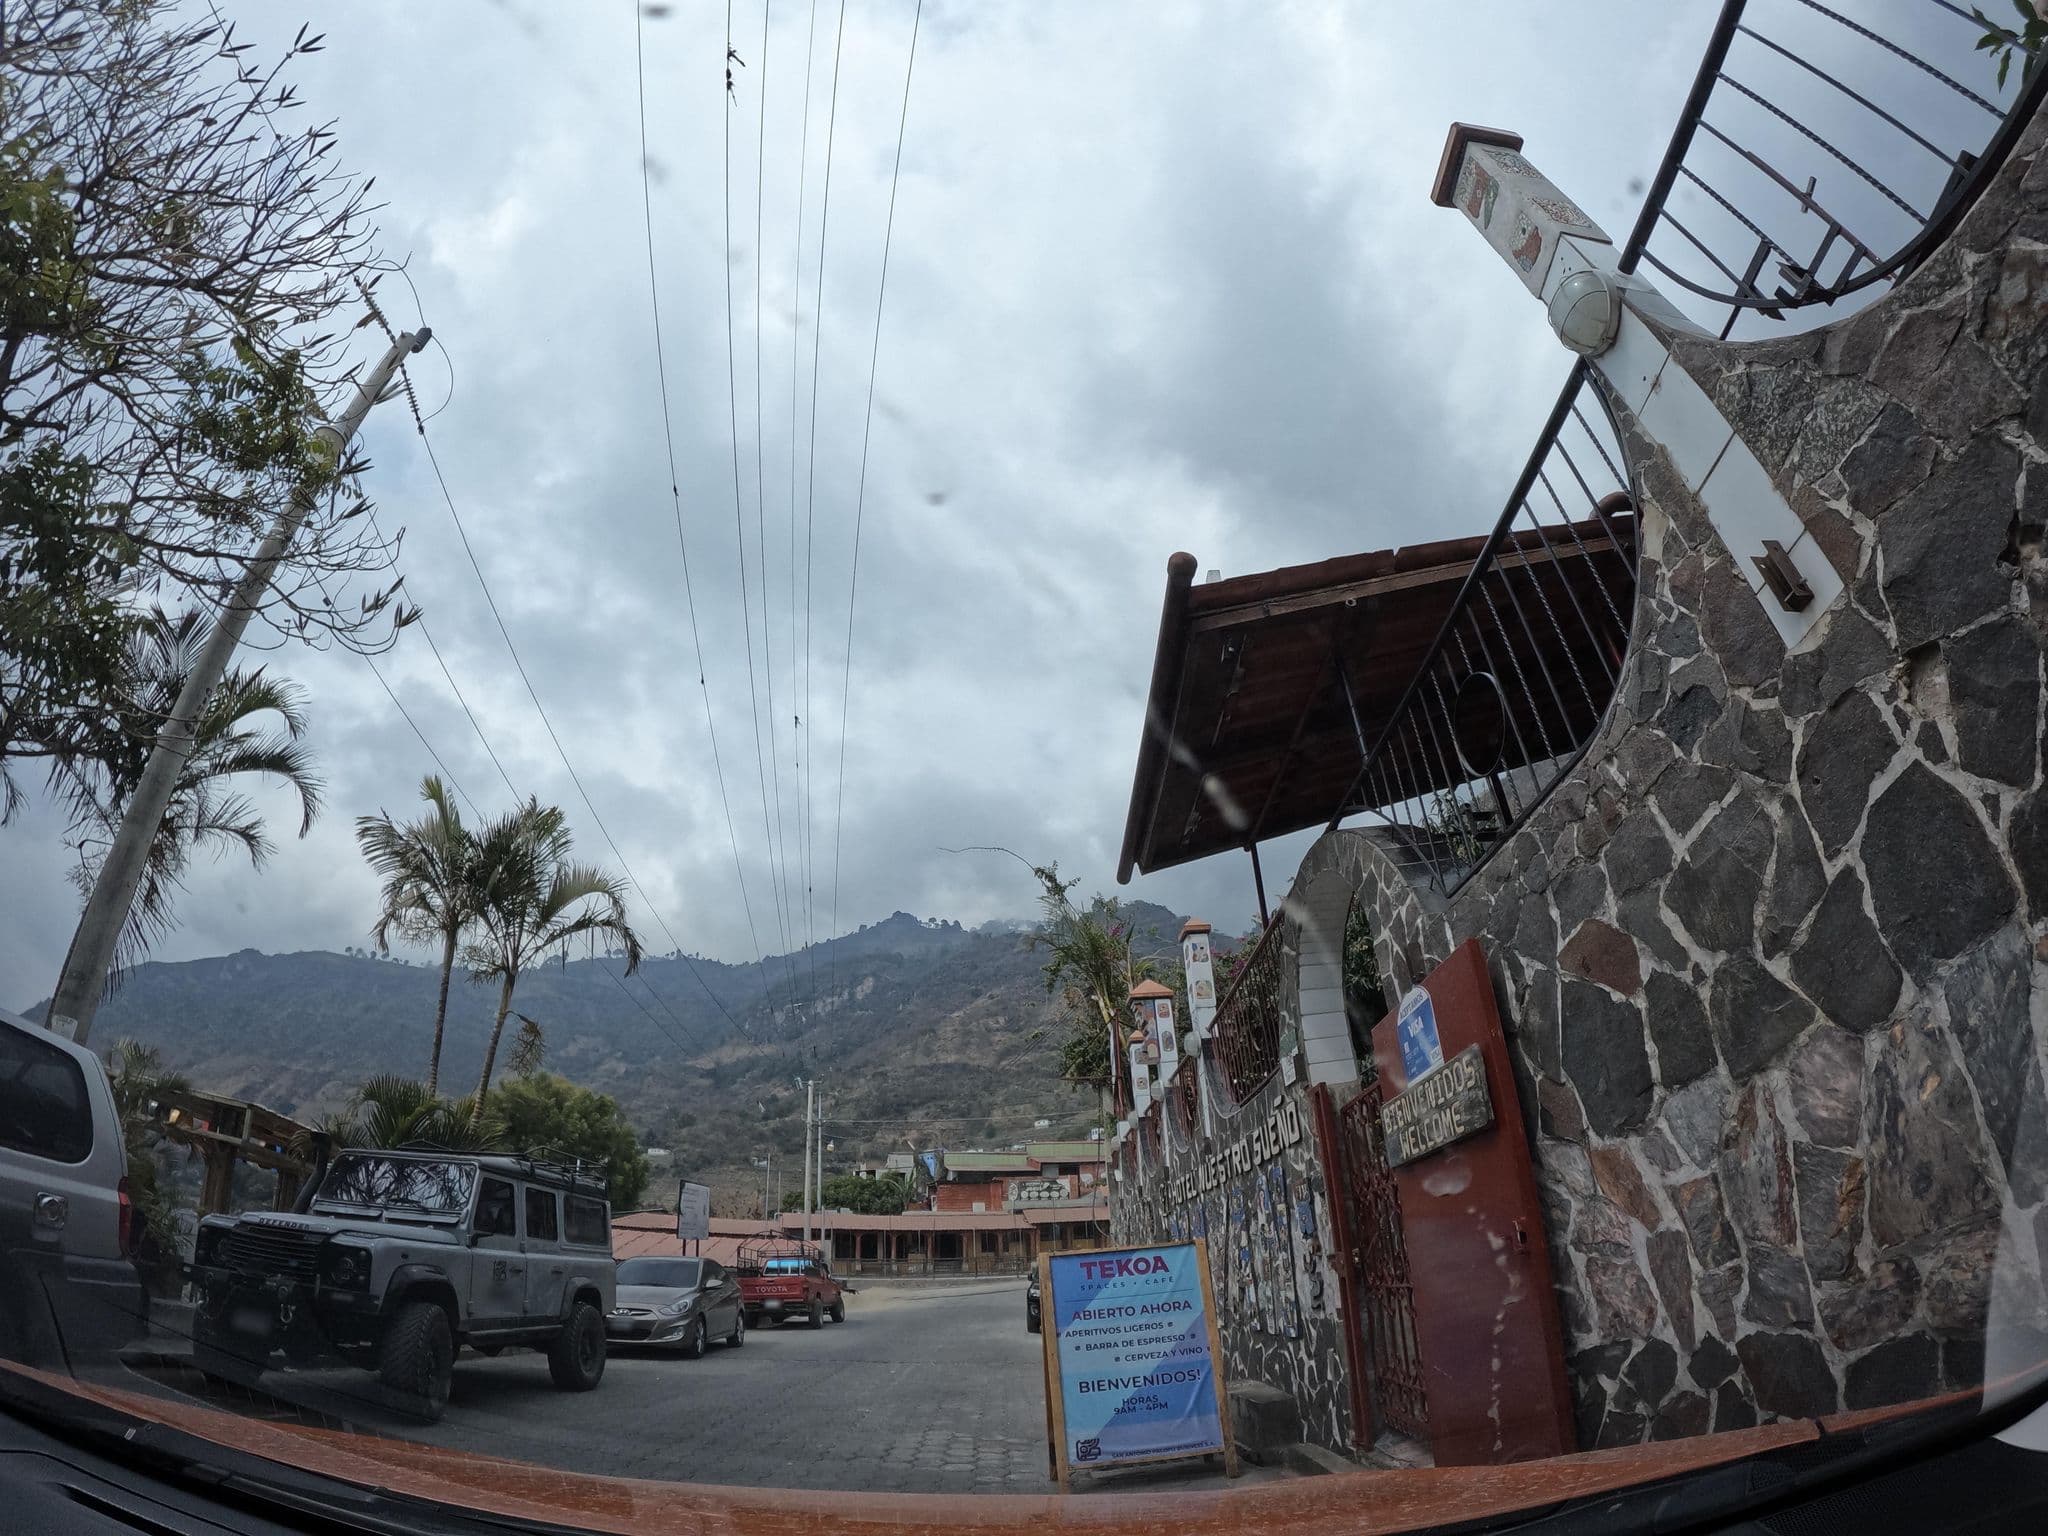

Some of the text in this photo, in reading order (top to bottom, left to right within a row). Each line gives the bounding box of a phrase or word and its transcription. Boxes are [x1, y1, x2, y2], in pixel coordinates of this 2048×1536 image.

[1383, 1055, 1475, 1134] BIENVENIDOS
[1400, 1101, 1464, 1159] WELCOME
[1170, 1173, 1197, 1205] HOTEL
[1199, 1138, 1251, 1192] NUESTRO
[1253, 1095, 1300, 1166] SUEÑO
[1080, 1255, 1170, 1280] TEKOA
[1080, 1276, 1174, 1292] SPACES CAFÉ
[1072, 1300, 1192, 1321] ABIERTO AHORA
[1065, 1322, 1164, 1338] APERITIVOS LIGEROS
[1085, 1334, 1185, 1352] BARRA DE ESPRESSO
[1124, 1346, 1203, 1362] CERVEZA Y VINO
[1079, 1369, 1201, 1393] BIENVENIDOS!
[1113, 1406, 1136, 1415] 9AM
[1145, 1402, 1168, 1411] 4PM
[1122, 1395, 1159, 1407] HORAS
